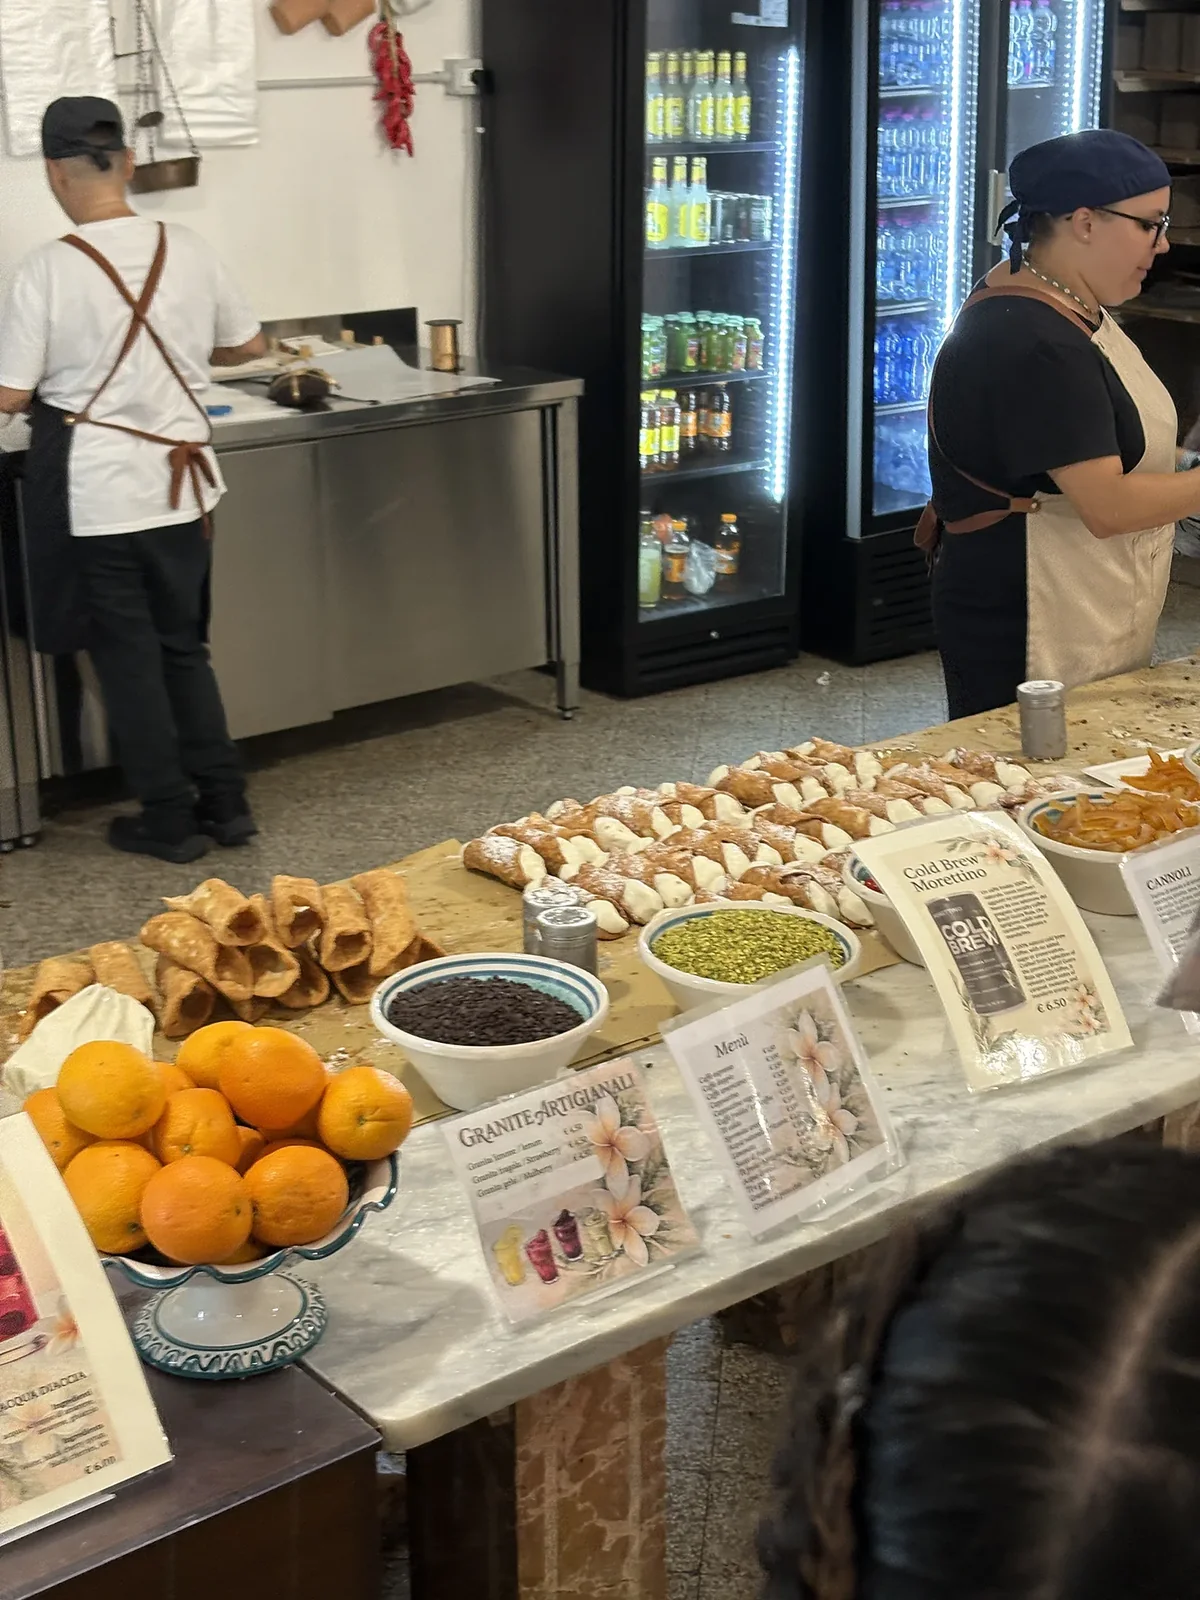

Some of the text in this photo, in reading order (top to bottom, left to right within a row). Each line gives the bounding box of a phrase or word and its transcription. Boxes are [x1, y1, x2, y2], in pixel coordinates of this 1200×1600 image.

[903, 853, 980, 880] Cold Brew
[1146, 866, 1192, 891] CANNOLI
[910, 866, 988, 893] Morettino
[941, 916, 992, 940] COLD
[948, 931, 999, 955] BREW
[1037, 998, 1067, 1013] € 6.50
[714, 1033, 750, 1058] Menù
[459, 1073, 635, 1147] GRANITE ARTIGIANALI
[526, 1147, 561, 1164] Strawberry
